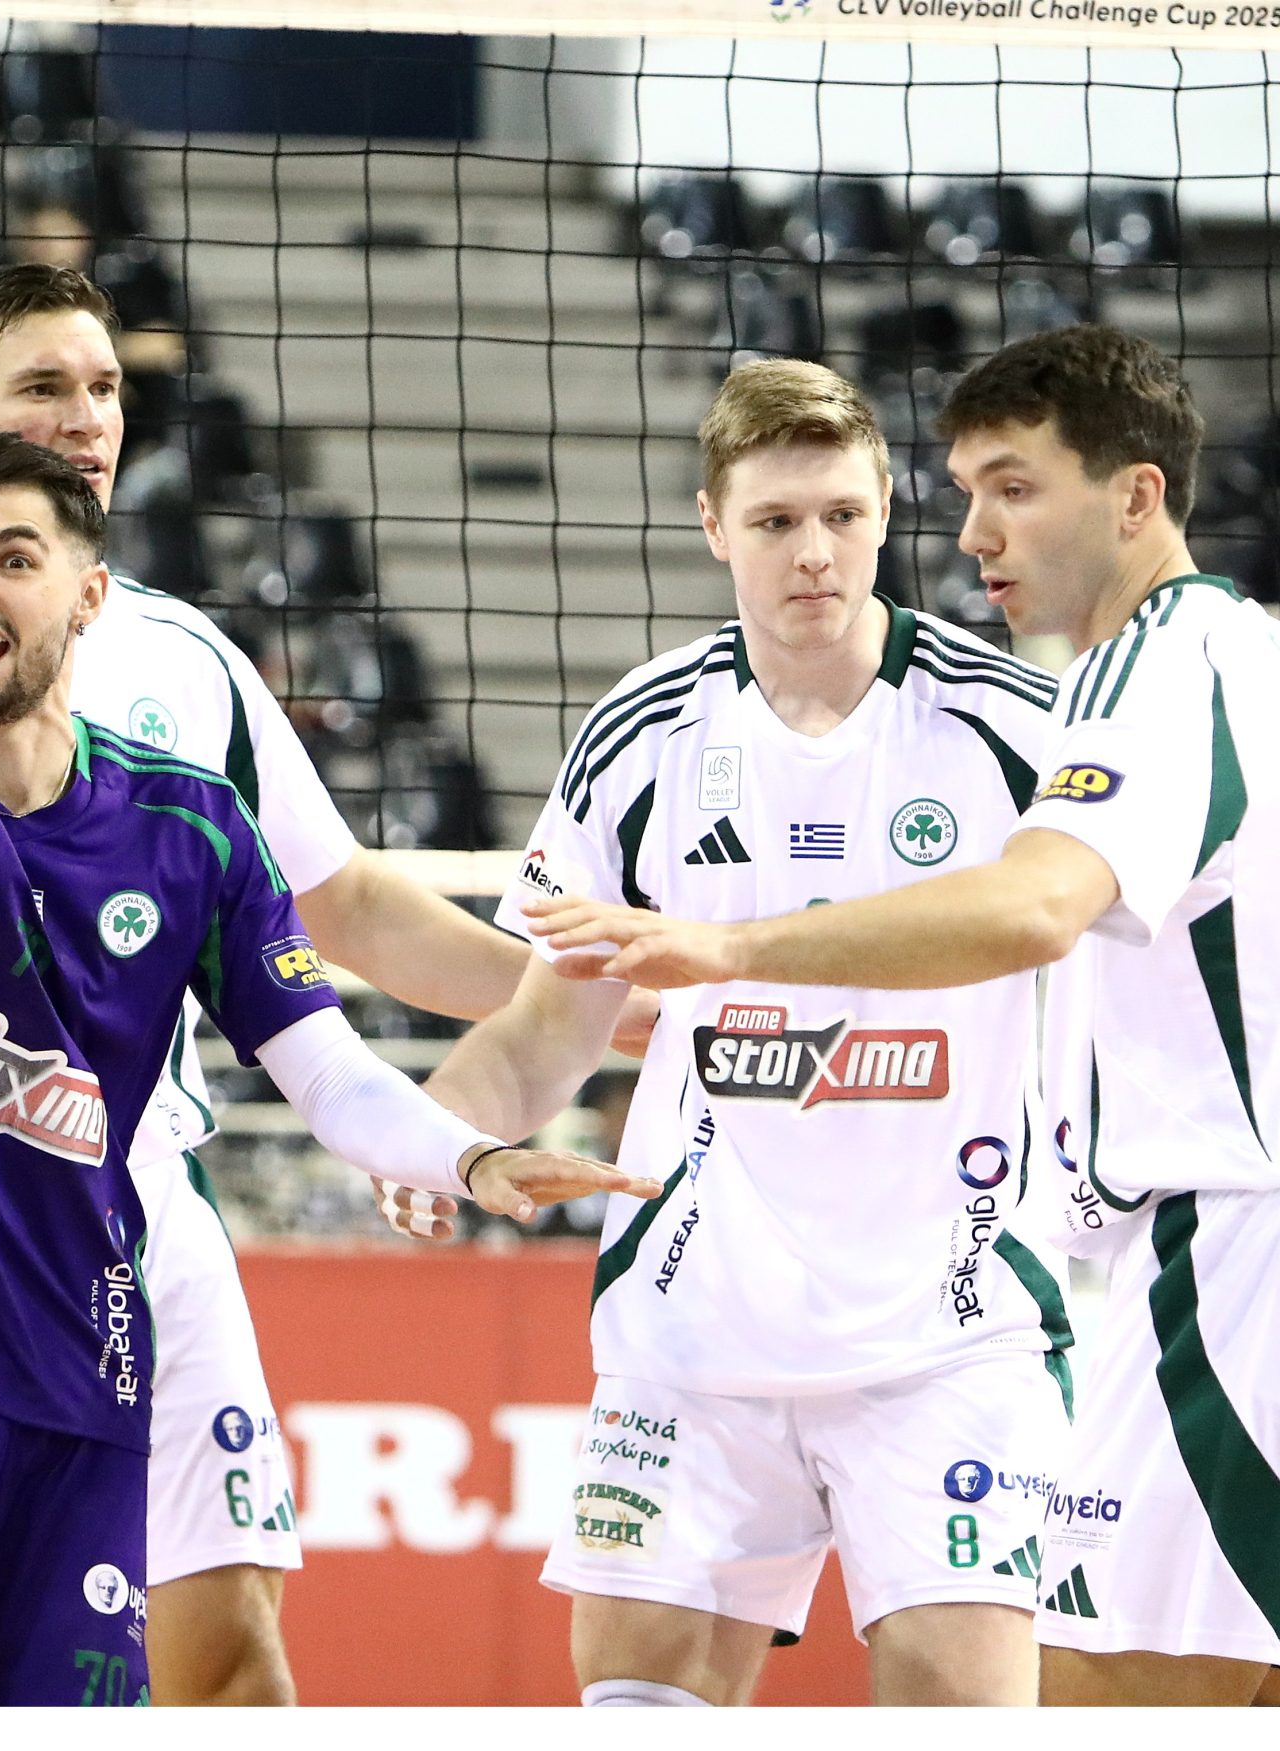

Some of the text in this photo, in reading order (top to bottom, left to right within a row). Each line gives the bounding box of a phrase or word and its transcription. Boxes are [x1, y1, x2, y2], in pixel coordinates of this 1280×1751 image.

[900, 0, 1022, 21] Volleyball
[1030, 0, 1158, 27] Challenge
[1166, 4, 1217, 30] Cup
[914, 851, 933, 859] 1908
[117, 944, 132, 953] 1908
[723, 1008, 780, 1031] pame
[91, 1279, 99, 1304] FULL
[91, 1306, 99, 1321] OF
[98, 1343, 112, 1379] SENSES
[225, 1468, 254, 1528] 6
[587, 1483, 662, 1519] FANTASY
[946, 1514, 980, 1568] 8
[74, 1649, 128, 1707] 70
